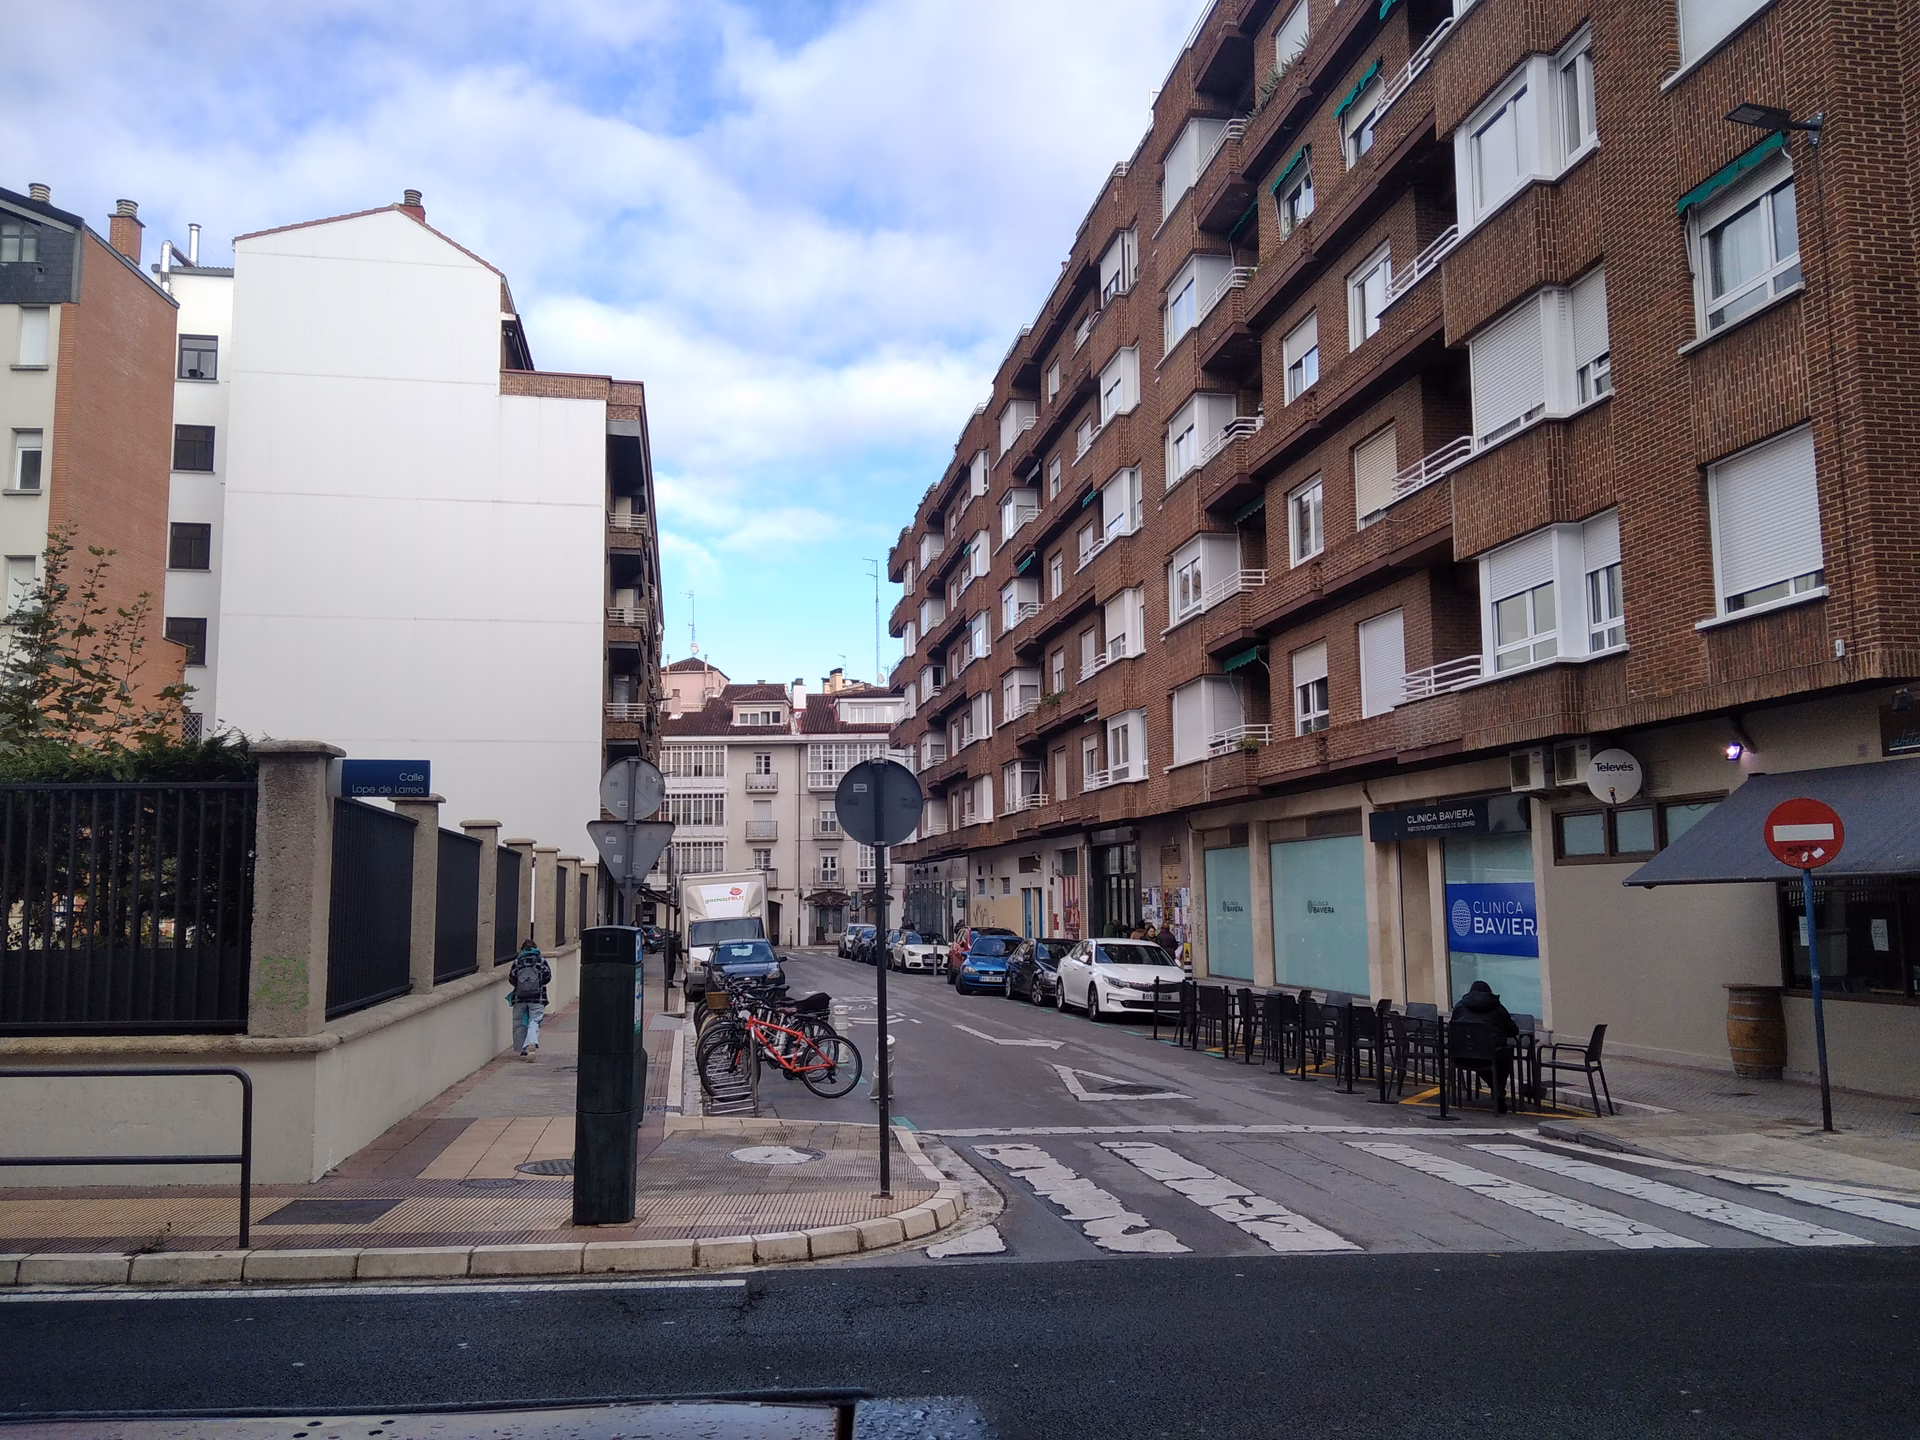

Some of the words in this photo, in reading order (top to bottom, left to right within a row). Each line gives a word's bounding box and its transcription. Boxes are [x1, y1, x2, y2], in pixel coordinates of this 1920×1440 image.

[1594, 761, 1634, 772] Televés
[399, 772, 424, 782] Calle
[352, 784, 376, 795] Lope
[378, 785, 392, 794] de
[394, 785, 424, 794] Larrea
[1407, 813, 1437, 823] CLINICA
[1439, 809, 1474, 820] BAVIERA
[1473, 901, 1524, 915] CLINICA
[1474, 917, 1539, 937] BAVIER
